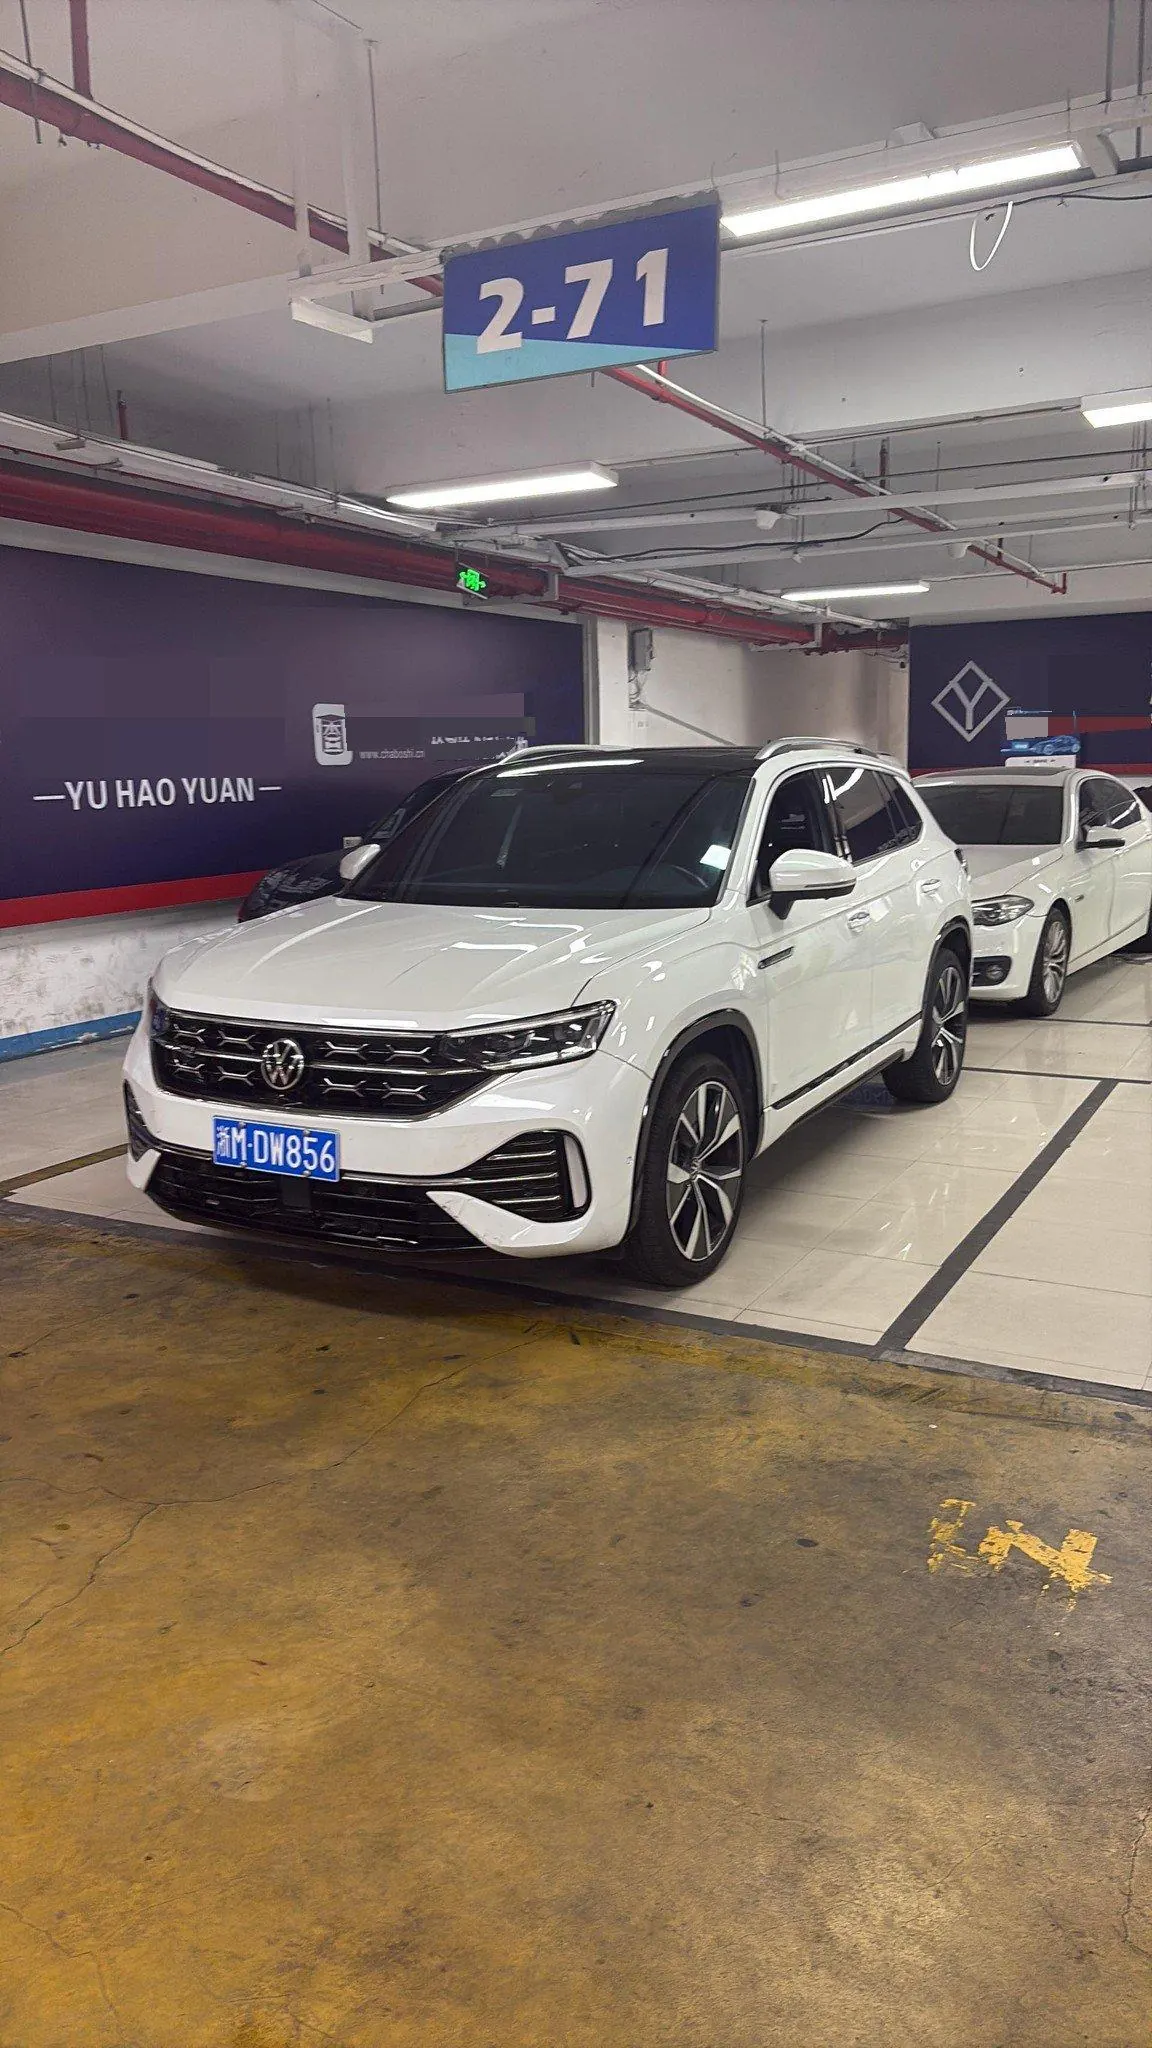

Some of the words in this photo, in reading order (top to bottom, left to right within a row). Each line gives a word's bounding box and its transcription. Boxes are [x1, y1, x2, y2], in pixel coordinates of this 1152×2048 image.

[476, 248, 670, 355] 2-71
[64, 780, 109, 811] YU
[115, 778, 177, 808] HAO
[181, 777, 255, 805] YUAN
